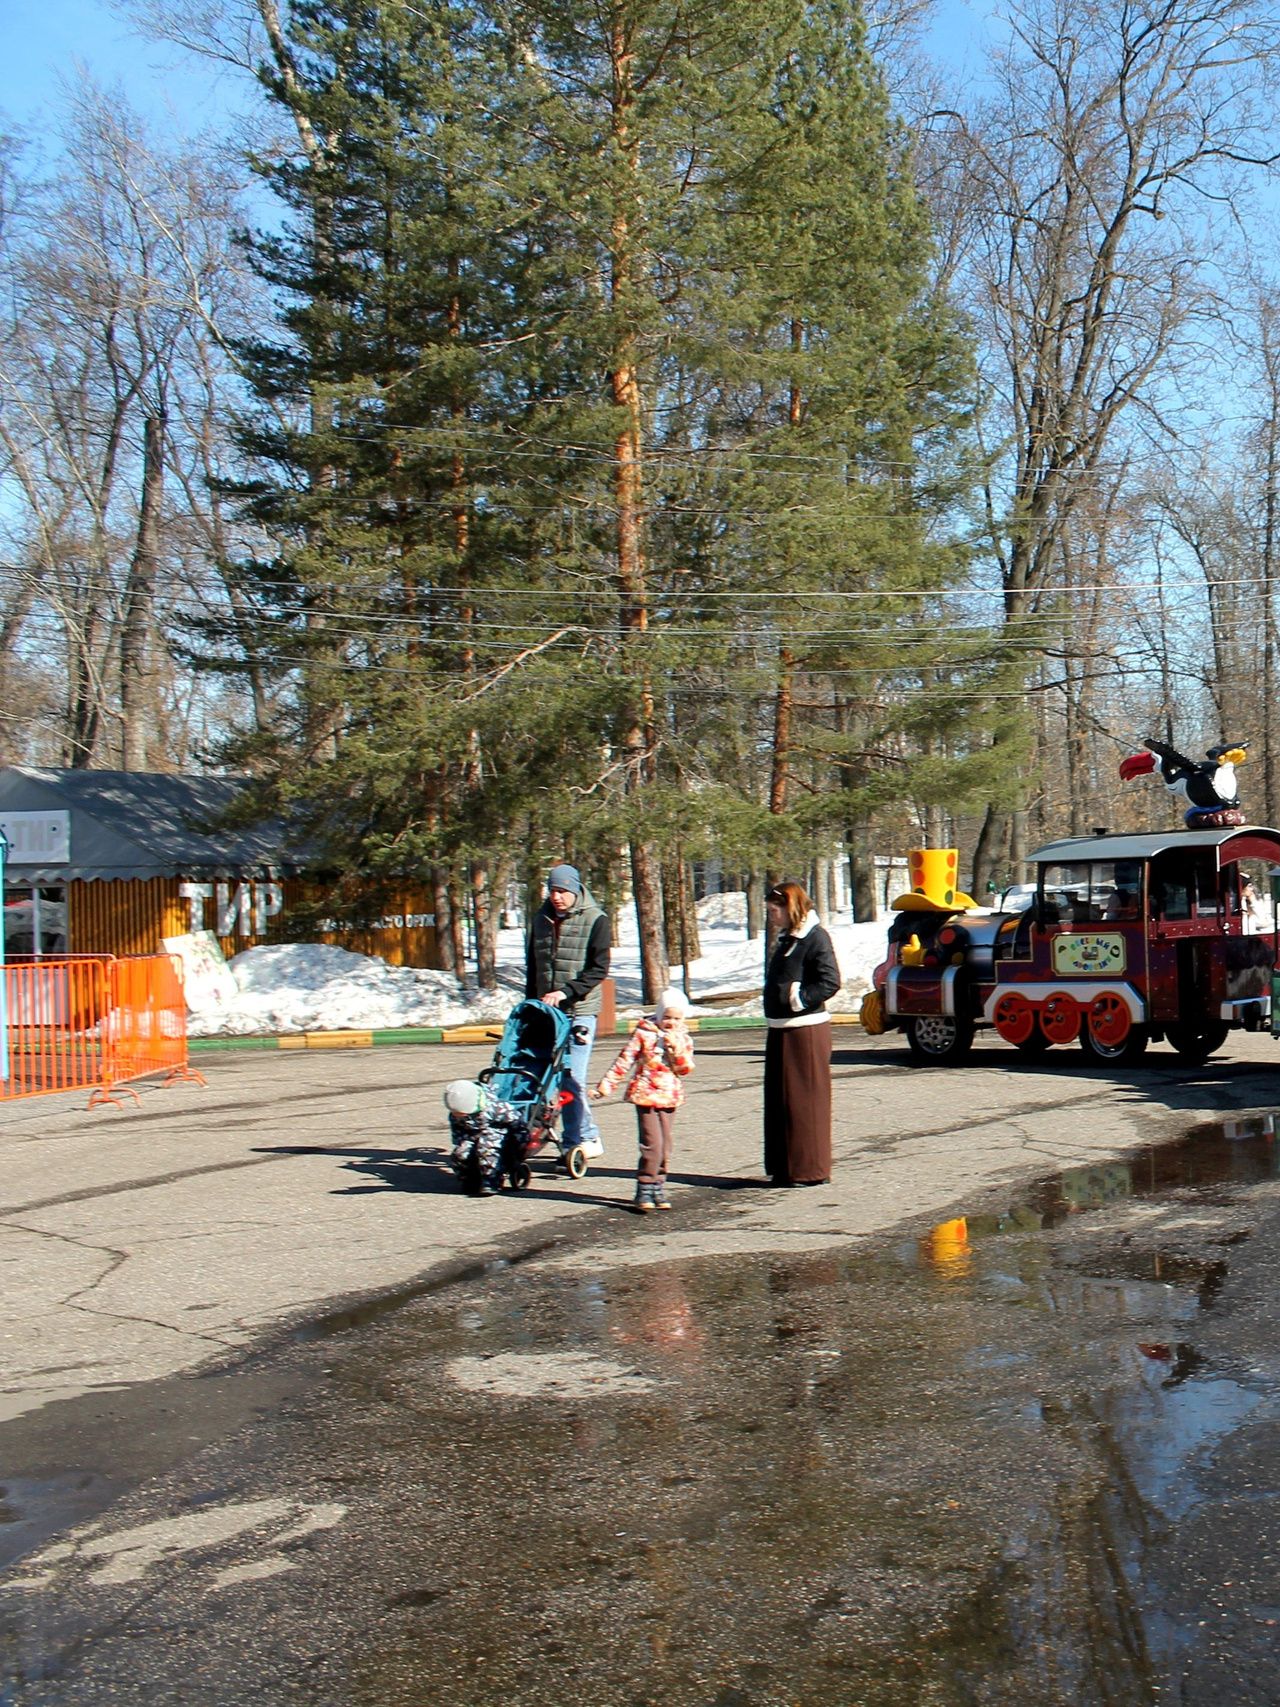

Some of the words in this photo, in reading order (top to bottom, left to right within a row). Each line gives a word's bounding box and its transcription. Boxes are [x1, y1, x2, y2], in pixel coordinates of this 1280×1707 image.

[11, 820, 62, 852] ТИР
[178, 882, 283, 936] ТИР
[405, 913, 436, 928] ОРУЖ
